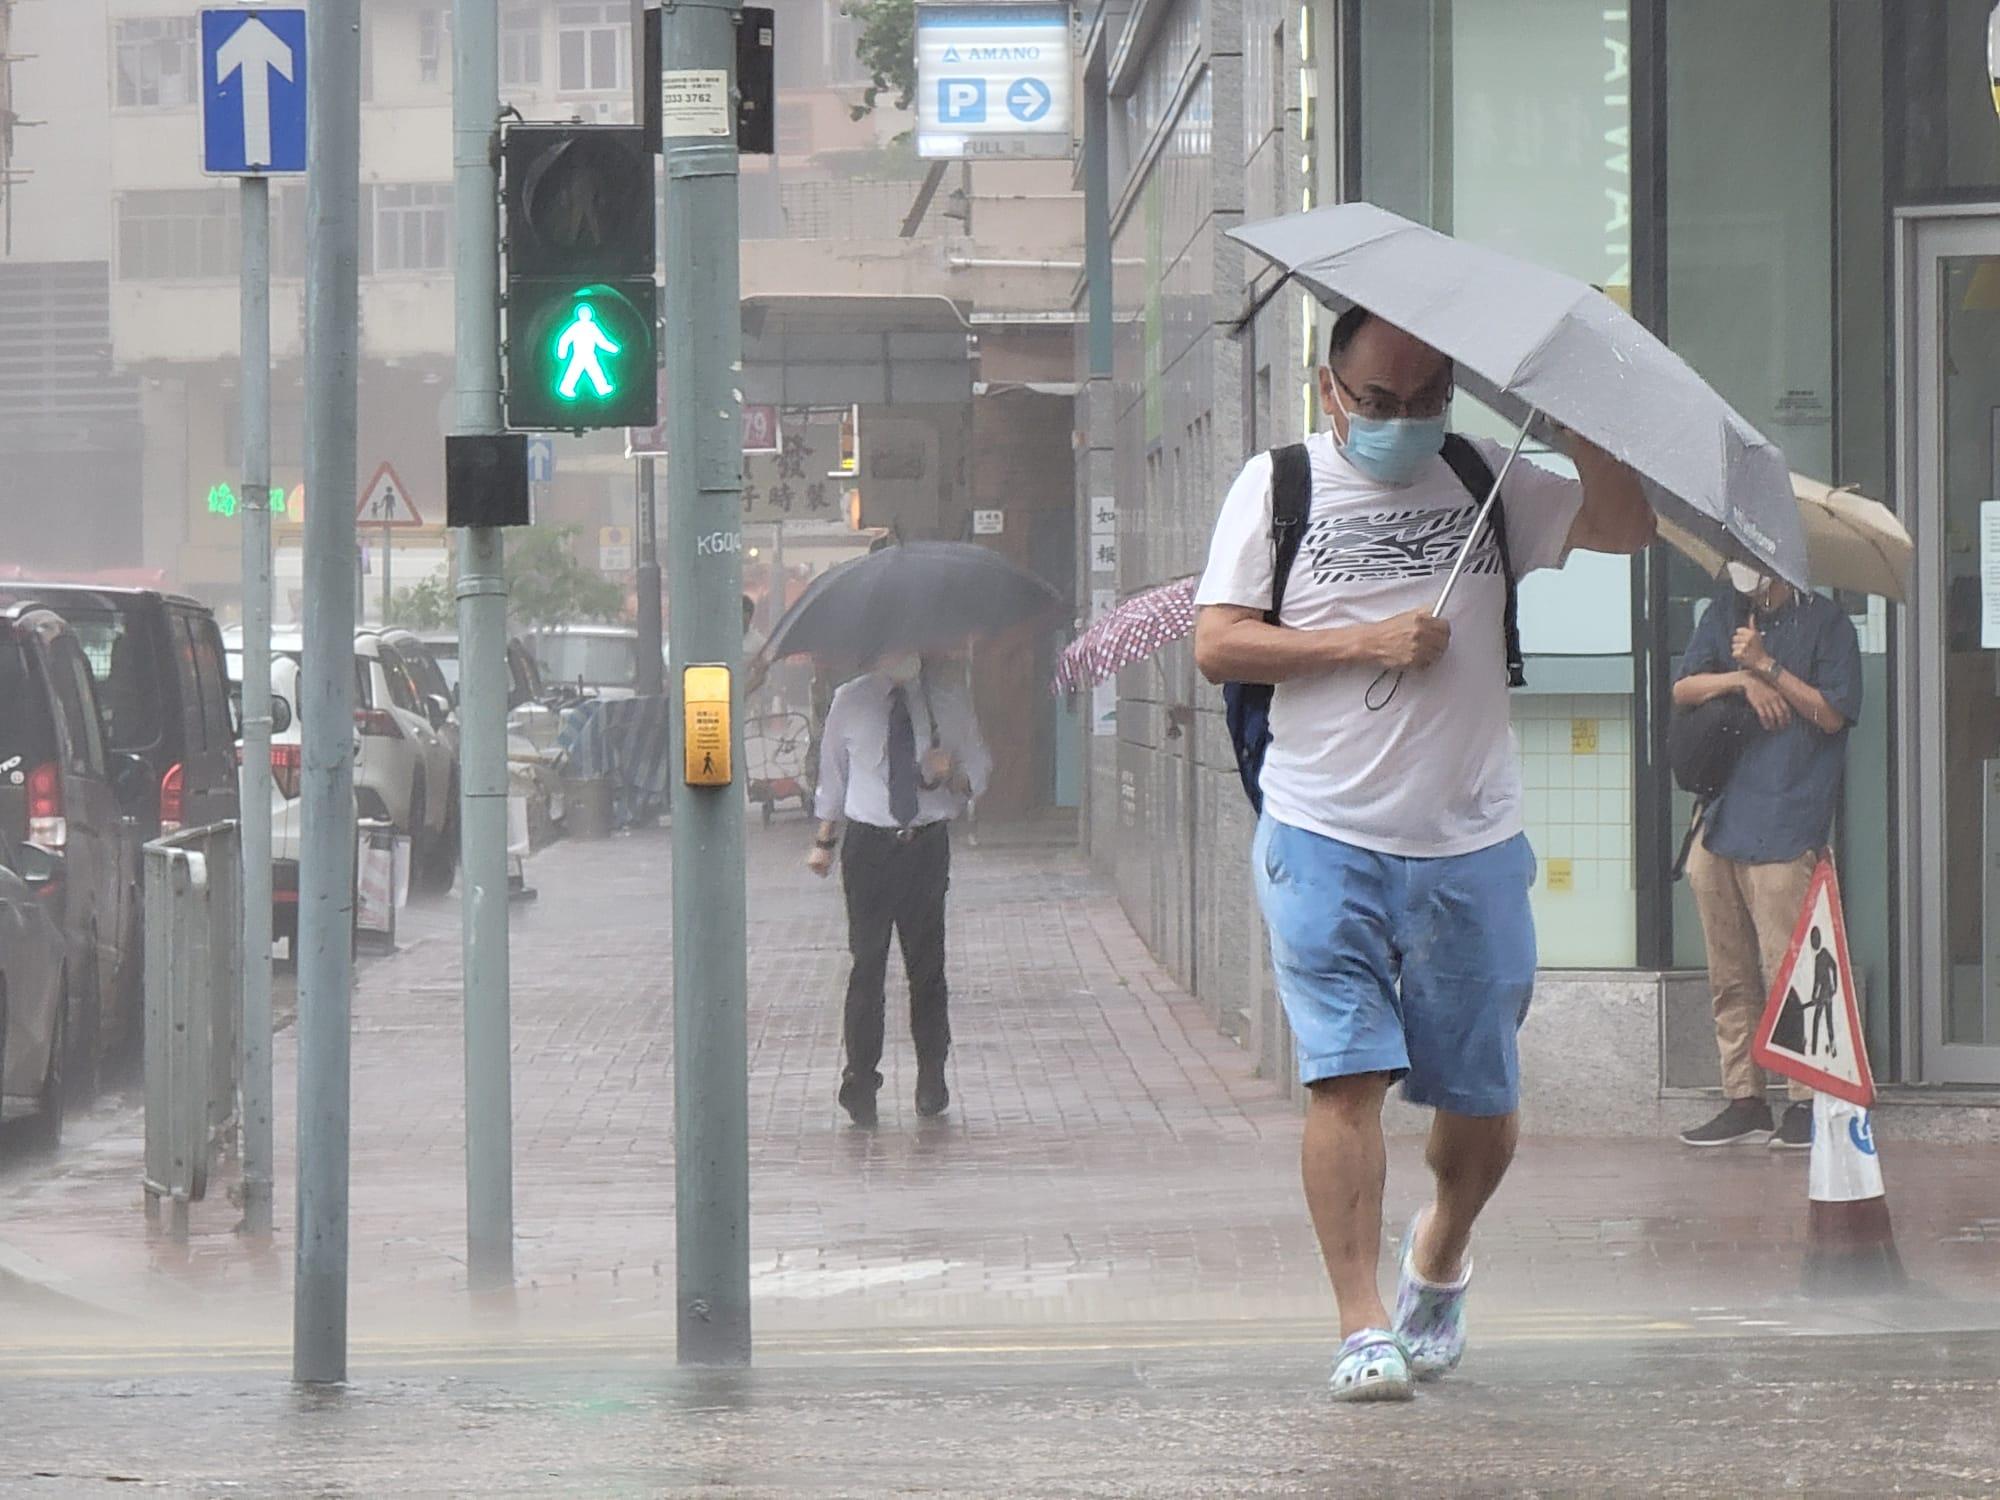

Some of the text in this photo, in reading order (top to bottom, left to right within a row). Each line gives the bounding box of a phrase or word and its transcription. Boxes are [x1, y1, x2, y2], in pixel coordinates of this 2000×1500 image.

[968, 47, 1040, 60] AMANO
[685, 93, 711, 103] 3762
[948, 83, 979, 117] P
[962, 141, 1002, 154] FULL
